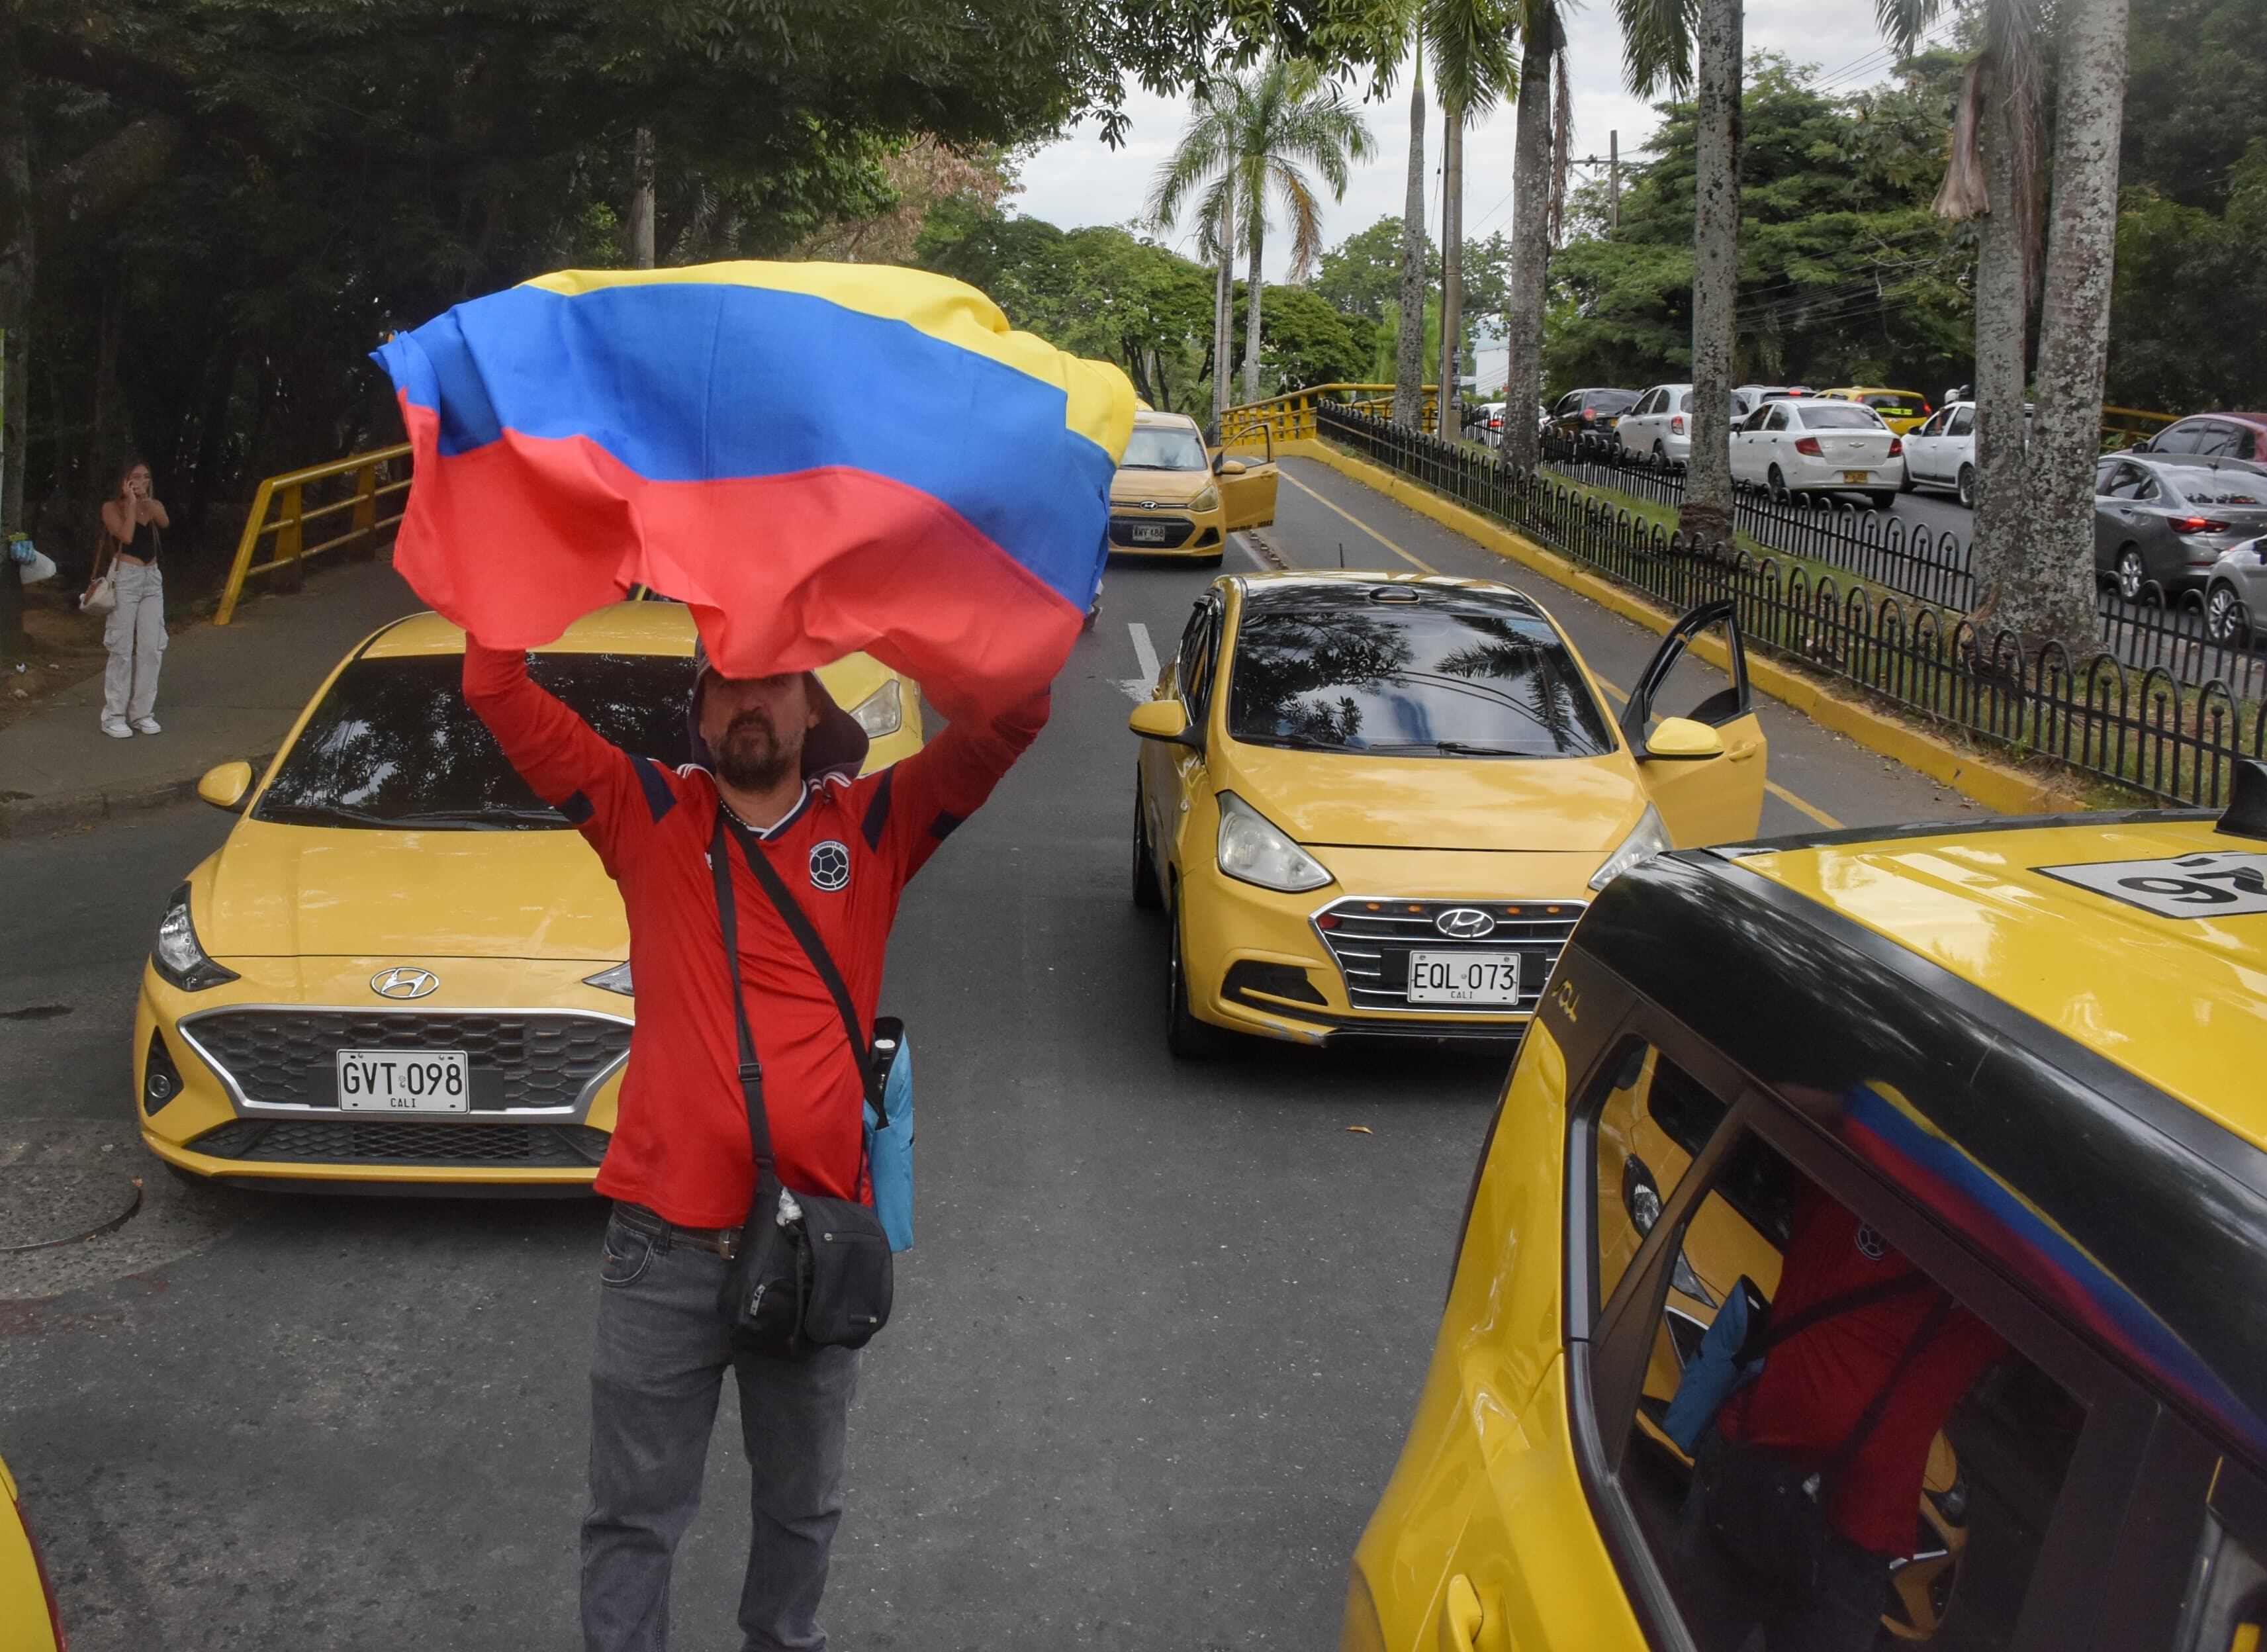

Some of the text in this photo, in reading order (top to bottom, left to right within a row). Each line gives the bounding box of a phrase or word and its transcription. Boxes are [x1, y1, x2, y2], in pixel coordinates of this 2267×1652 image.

[1414, 962, 1514, 990] EQL 073
[1450, 990, 1473, 999] CALI
[343, 1062, 463, 1096] GVT 098
[391, 1097, 416, 1108] CALI
